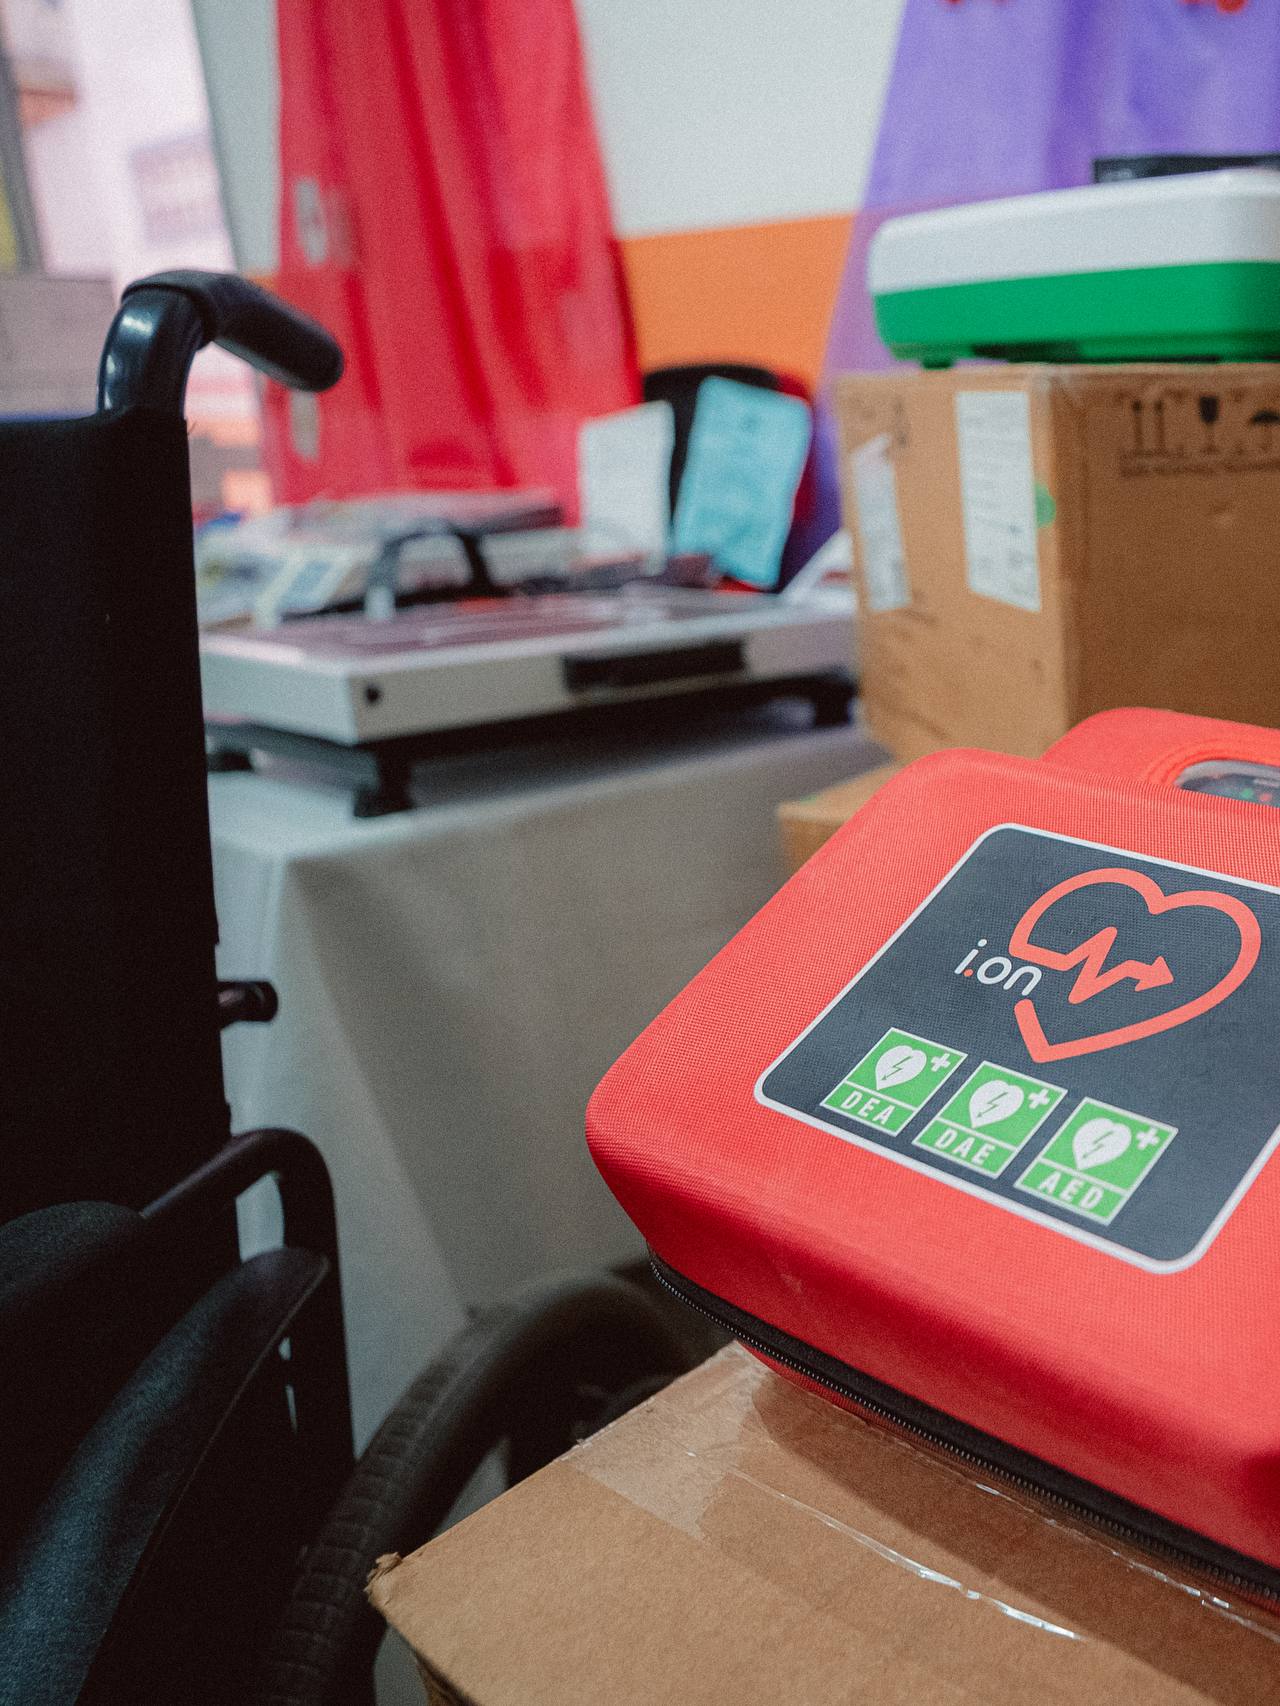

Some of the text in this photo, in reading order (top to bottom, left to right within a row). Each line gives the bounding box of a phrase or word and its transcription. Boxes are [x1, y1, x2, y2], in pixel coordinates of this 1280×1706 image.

[953, 938, 1043, 997] i.on
[839, 1091, 896, 1126] DEA
[933, 1130, 996, 1167] DAE
[1036, 1172, 1105, 1212] AED
